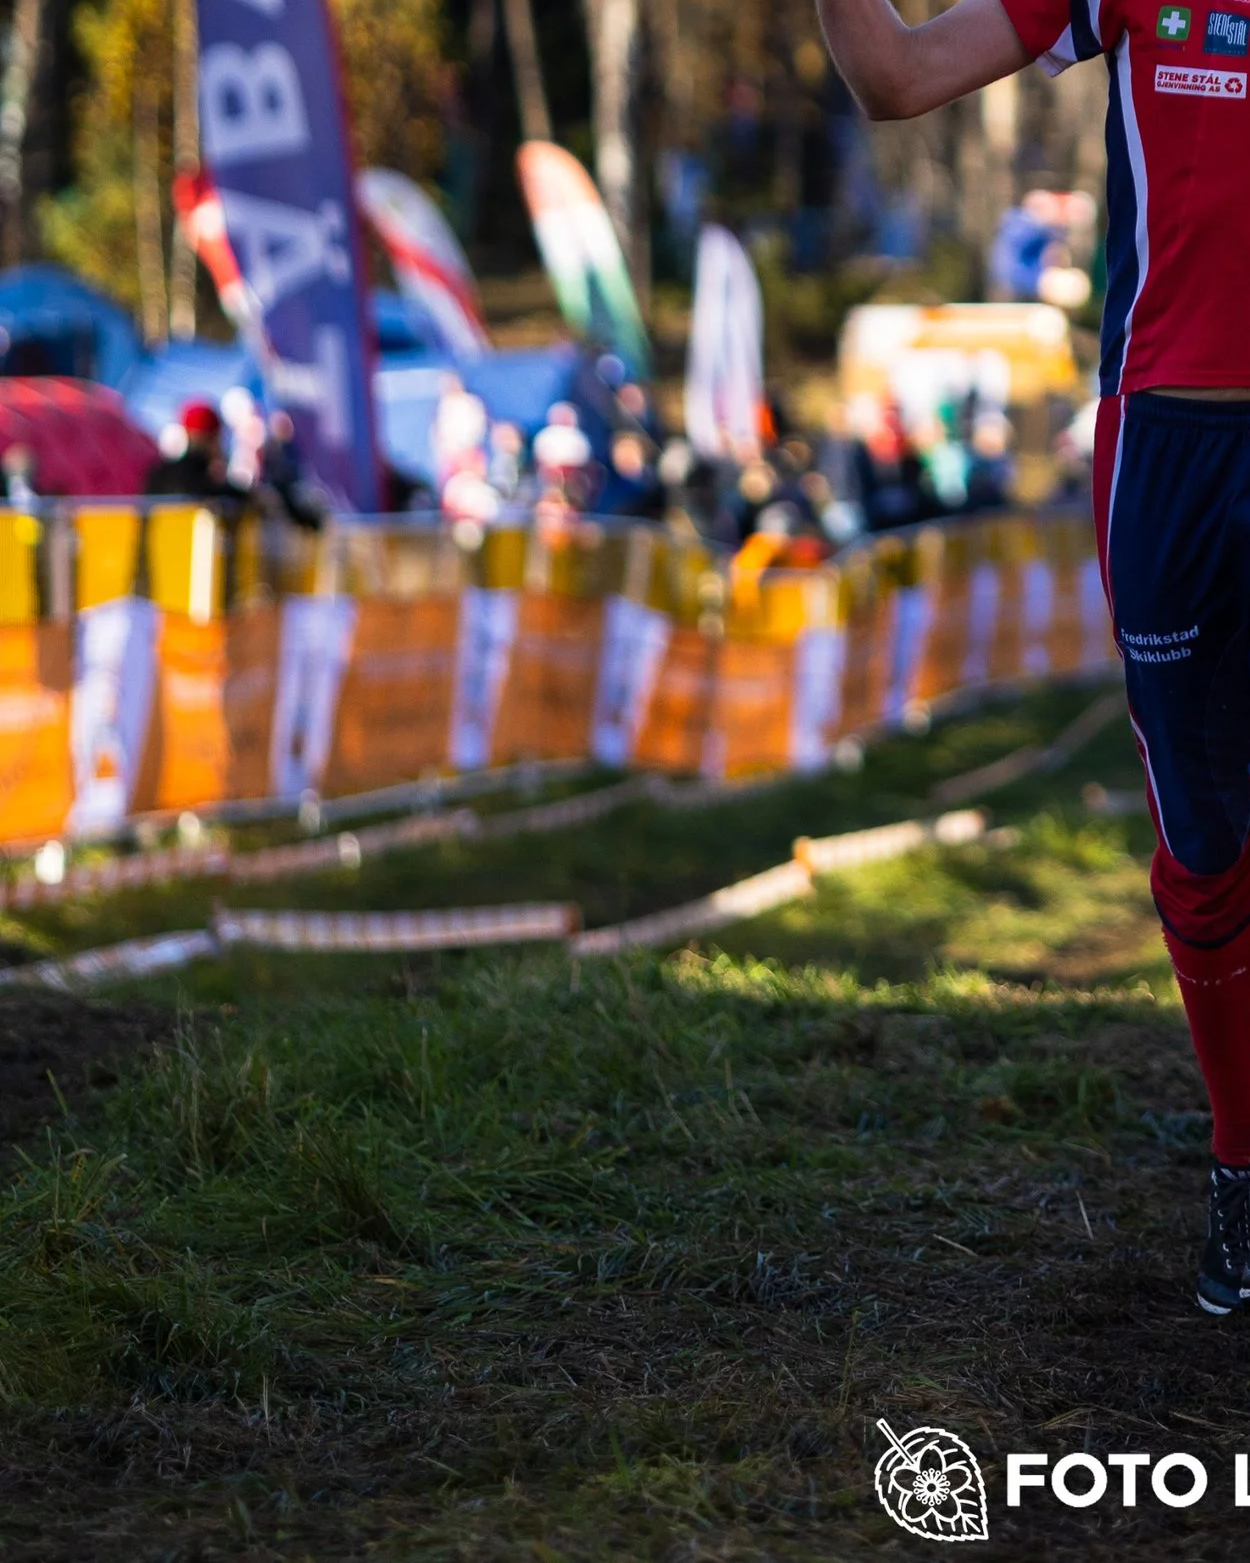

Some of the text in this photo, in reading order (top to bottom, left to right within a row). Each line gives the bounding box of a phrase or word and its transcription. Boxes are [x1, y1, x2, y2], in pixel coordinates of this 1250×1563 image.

[1157, 71, 1221, 85] STENE STÅL
[1156, 81, 1221, 93] GJENVINNING AS
